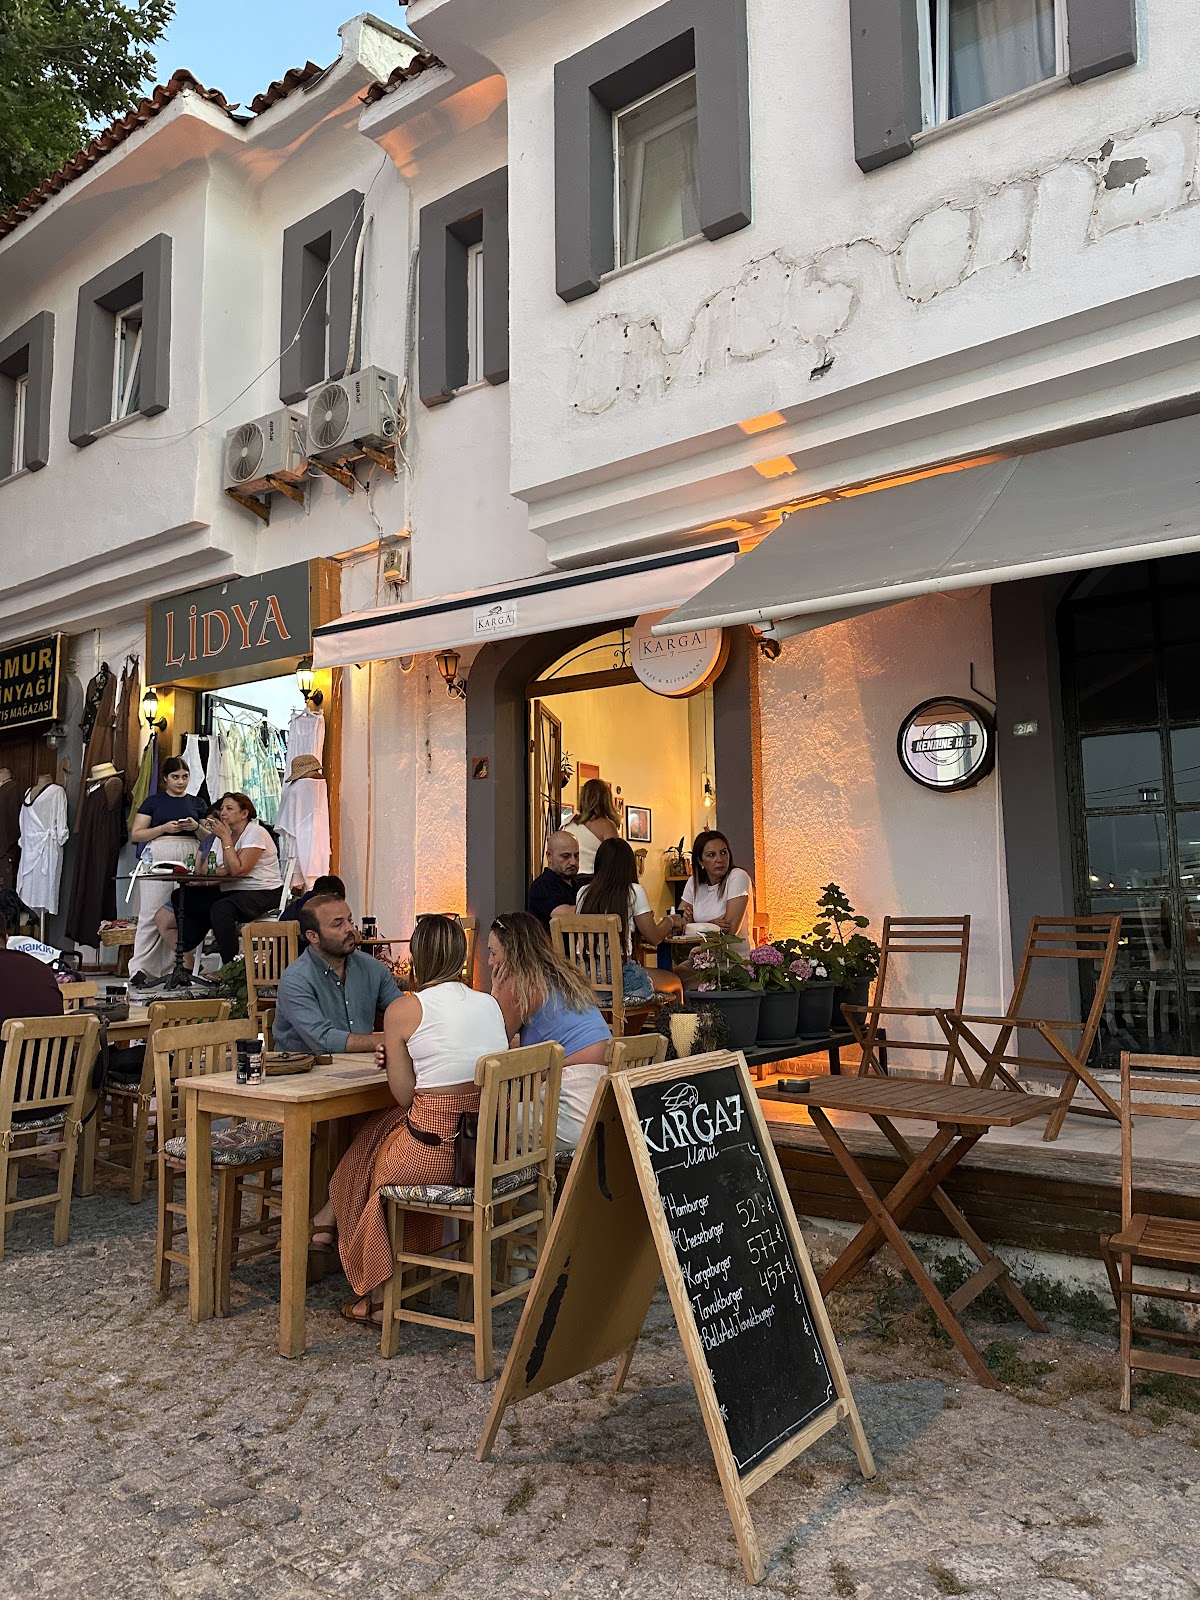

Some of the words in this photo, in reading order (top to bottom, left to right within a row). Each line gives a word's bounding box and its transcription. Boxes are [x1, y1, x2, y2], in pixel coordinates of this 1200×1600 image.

[166, 595, 291, 667] LİDYA
[478, 614, 512, 628] KARGA
[643, 632, 702, 655] KARGA
[0, 648, 52, 680] MUR
[10, 700, 52, 719] MAĞAZASI
[683, 1141, 719, 1168] Menü
[666, 1193, 710, 1219] Hamburger
[677, 1222, 724, 1252] Cheeseburger
[684, 1255, 731, 1289] Kargaburger
